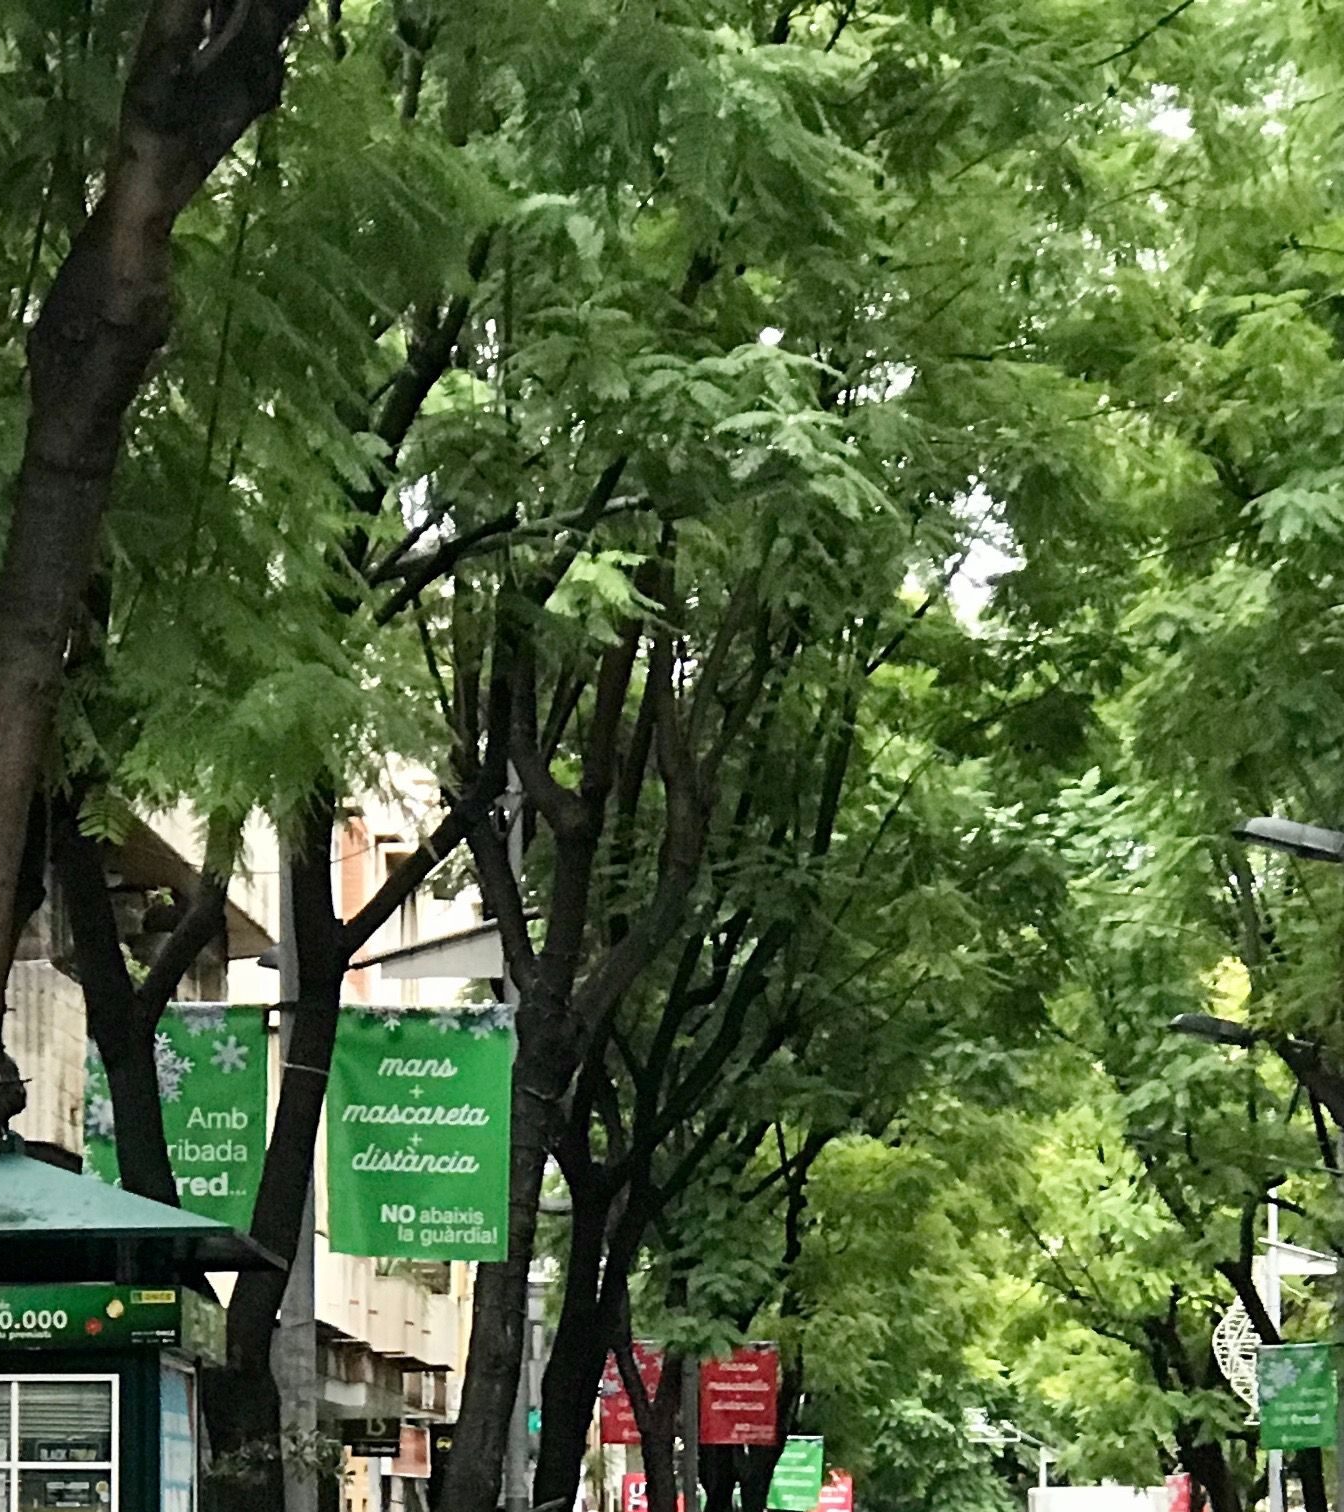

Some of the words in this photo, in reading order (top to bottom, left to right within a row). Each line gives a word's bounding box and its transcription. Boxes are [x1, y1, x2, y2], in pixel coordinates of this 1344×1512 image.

[377, 1058, 458, 1077] mans
[186, 1106, 249, 1130] Amb
[341, 1103, 490, 1126] mascareta
[167, 1139, 248, 1162] ribada
[351, 1143, 480, 1173] distància
[380, 1203, 416, 1223] NO
[419, 1206, 485, 1225] abaixis
[398, 1224, 414, 1242] la
[419, 1226, 498, 1247] guàrdia!
